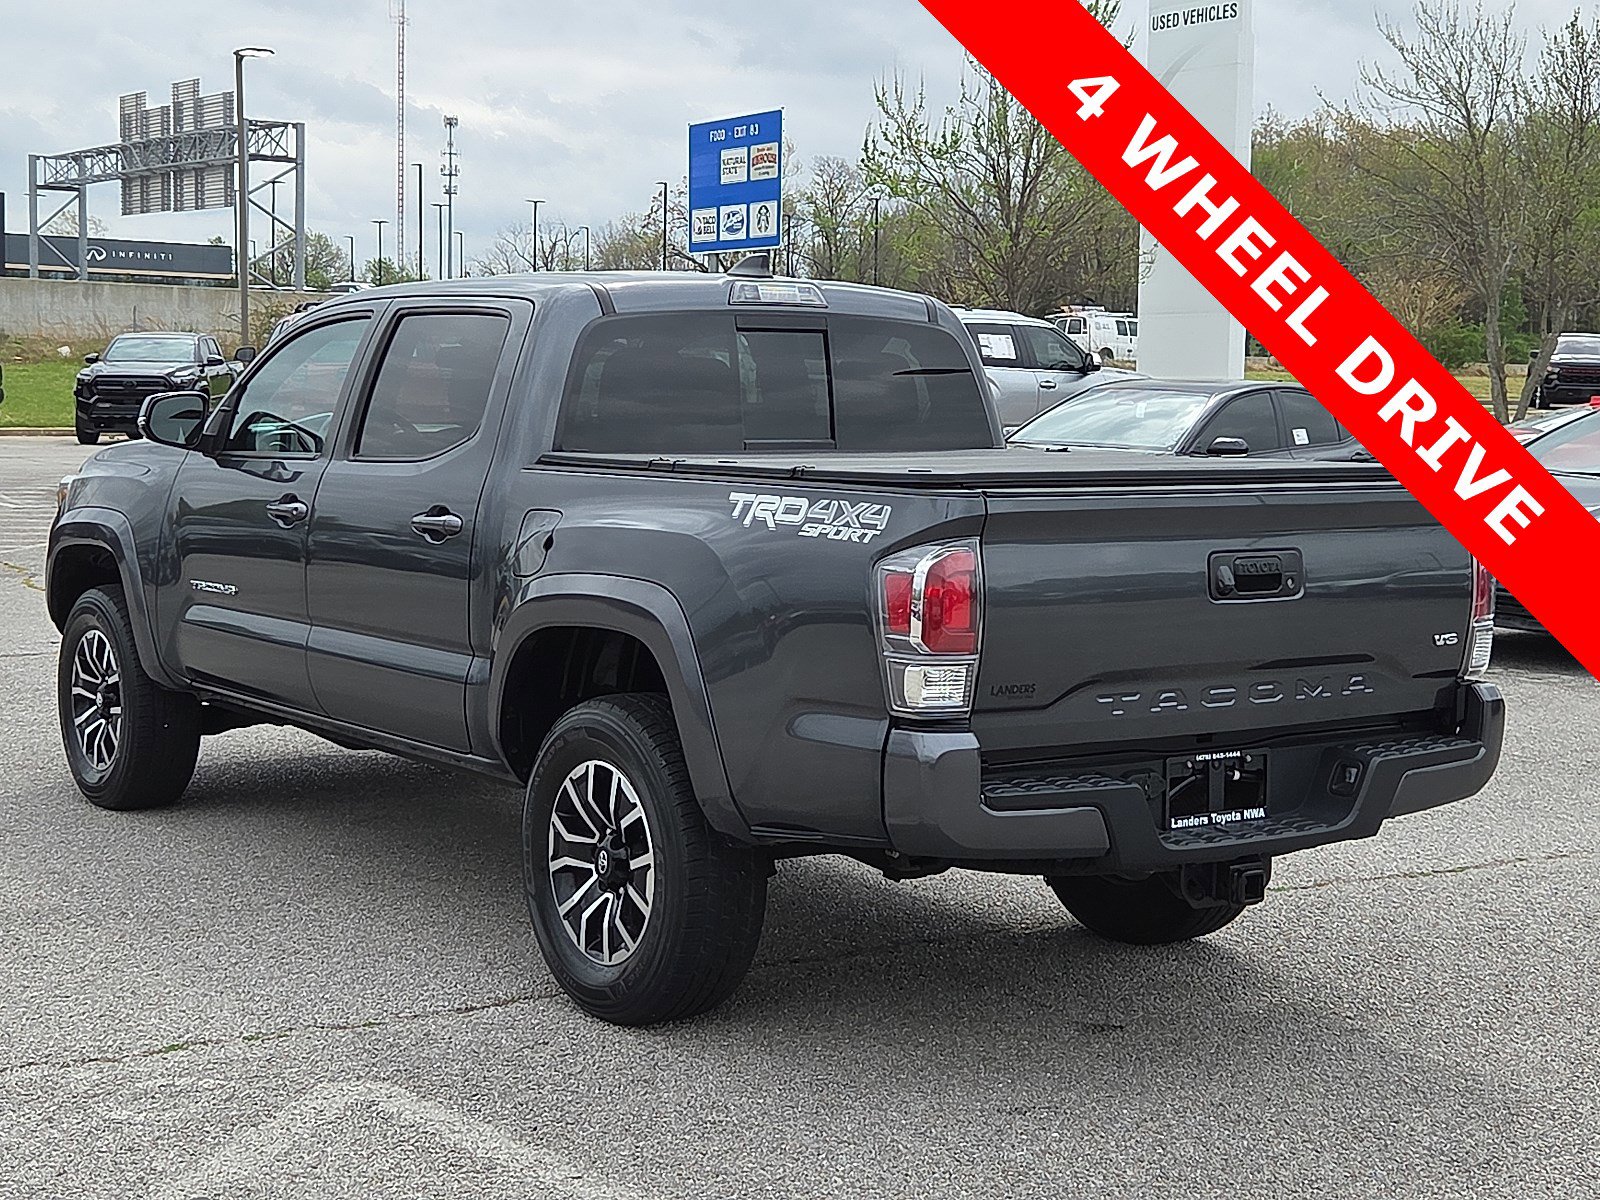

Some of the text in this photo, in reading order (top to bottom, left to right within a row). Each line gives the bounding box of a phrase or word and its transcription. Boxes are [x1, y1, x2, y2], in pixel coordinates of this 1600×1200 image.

[1151, 2, 1238, 31] USED VEHICLES
[709, 129, 726, 143] FOOD
[733, 125, 748, 139] EXIT
[721, 155, 747, 167] NATURAL
[721, 166, 739, 176] STATE
[702, 215, 717, 225] TACO
[703, 225, 716, 235] BELL
[112, 250, 174, 261] INFINITI
[728, 491, 810, 531] TRD
[797, 522, 882, 544] SPORT
[1240, 561, 1281, 574] TOYOTA
[990, 683, 1037, 697] LANDERS
[1096, 674, 1375, 716] TACOMA
[1170, 807, 1266, 829] Landers Toyota NWA
